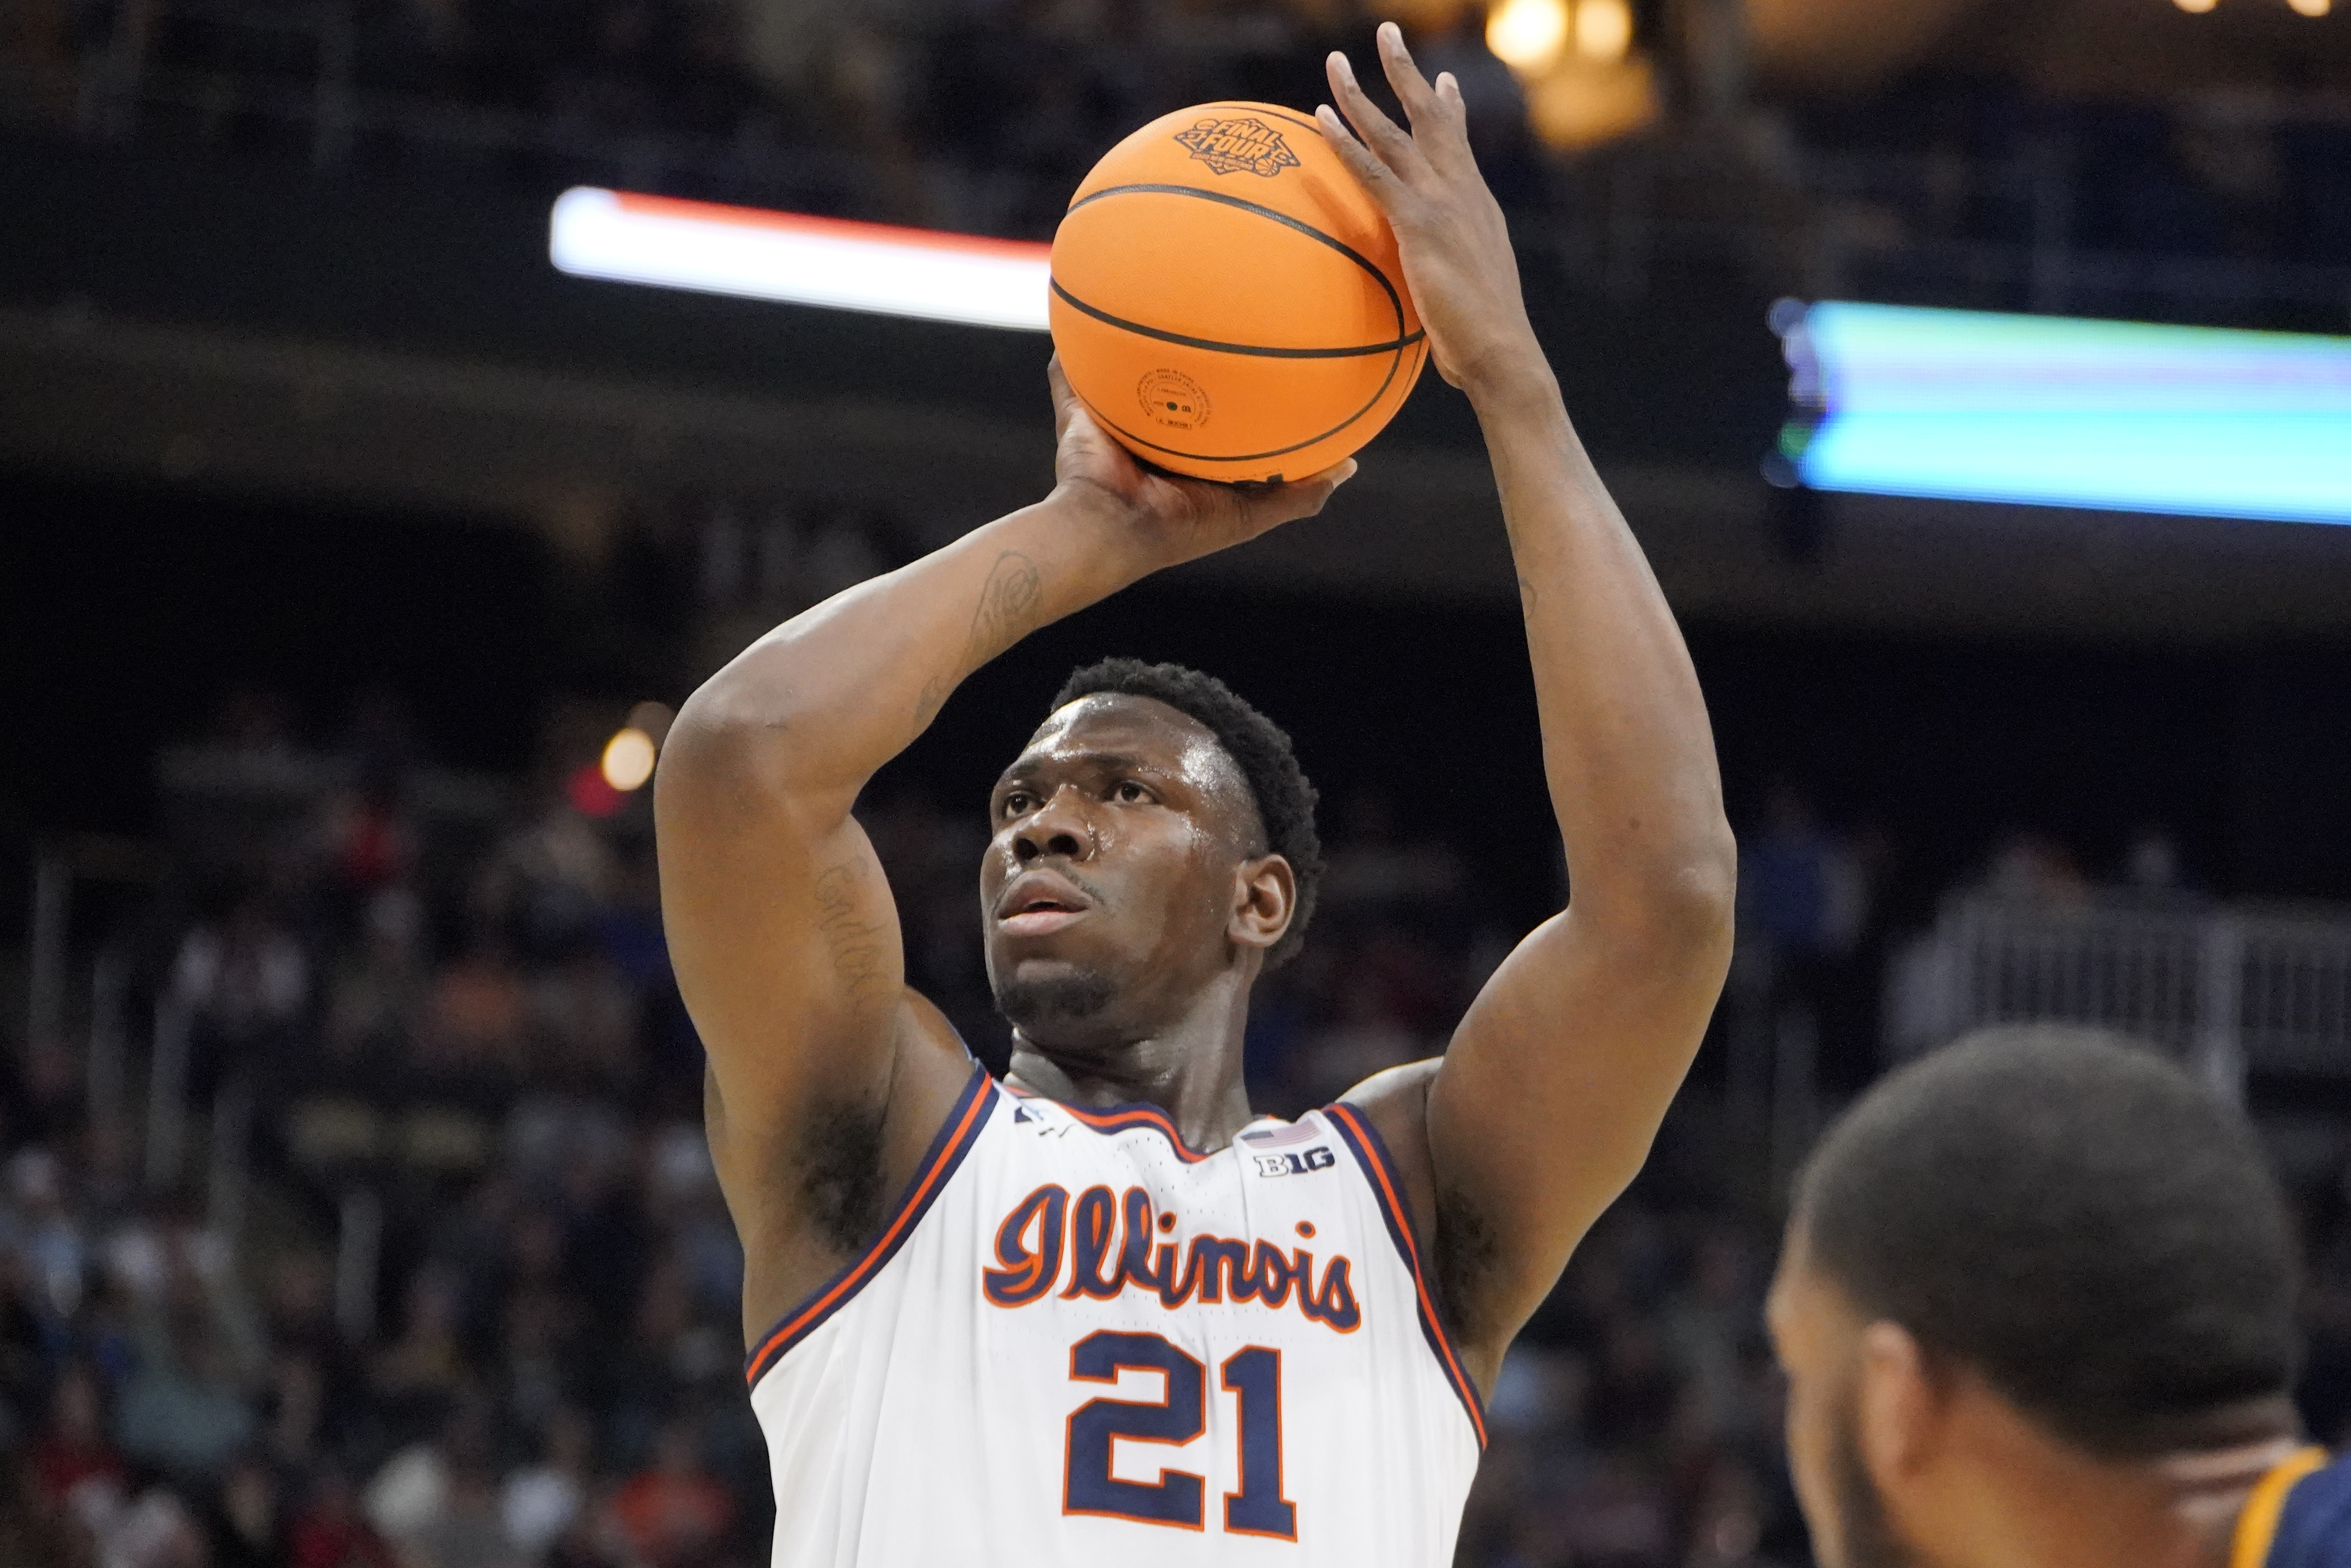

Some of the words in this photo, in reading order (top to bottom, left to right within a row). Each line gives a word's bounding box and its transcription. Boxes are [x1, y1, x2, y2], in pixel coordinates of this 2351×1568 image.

[1198, 133, 1270, 160] FOUR
[1212, 120, 1280, 146] FINAL
[982, 1183, 1361, 1334] Illinois
[1062, 1329, 1298, 1543] 21
